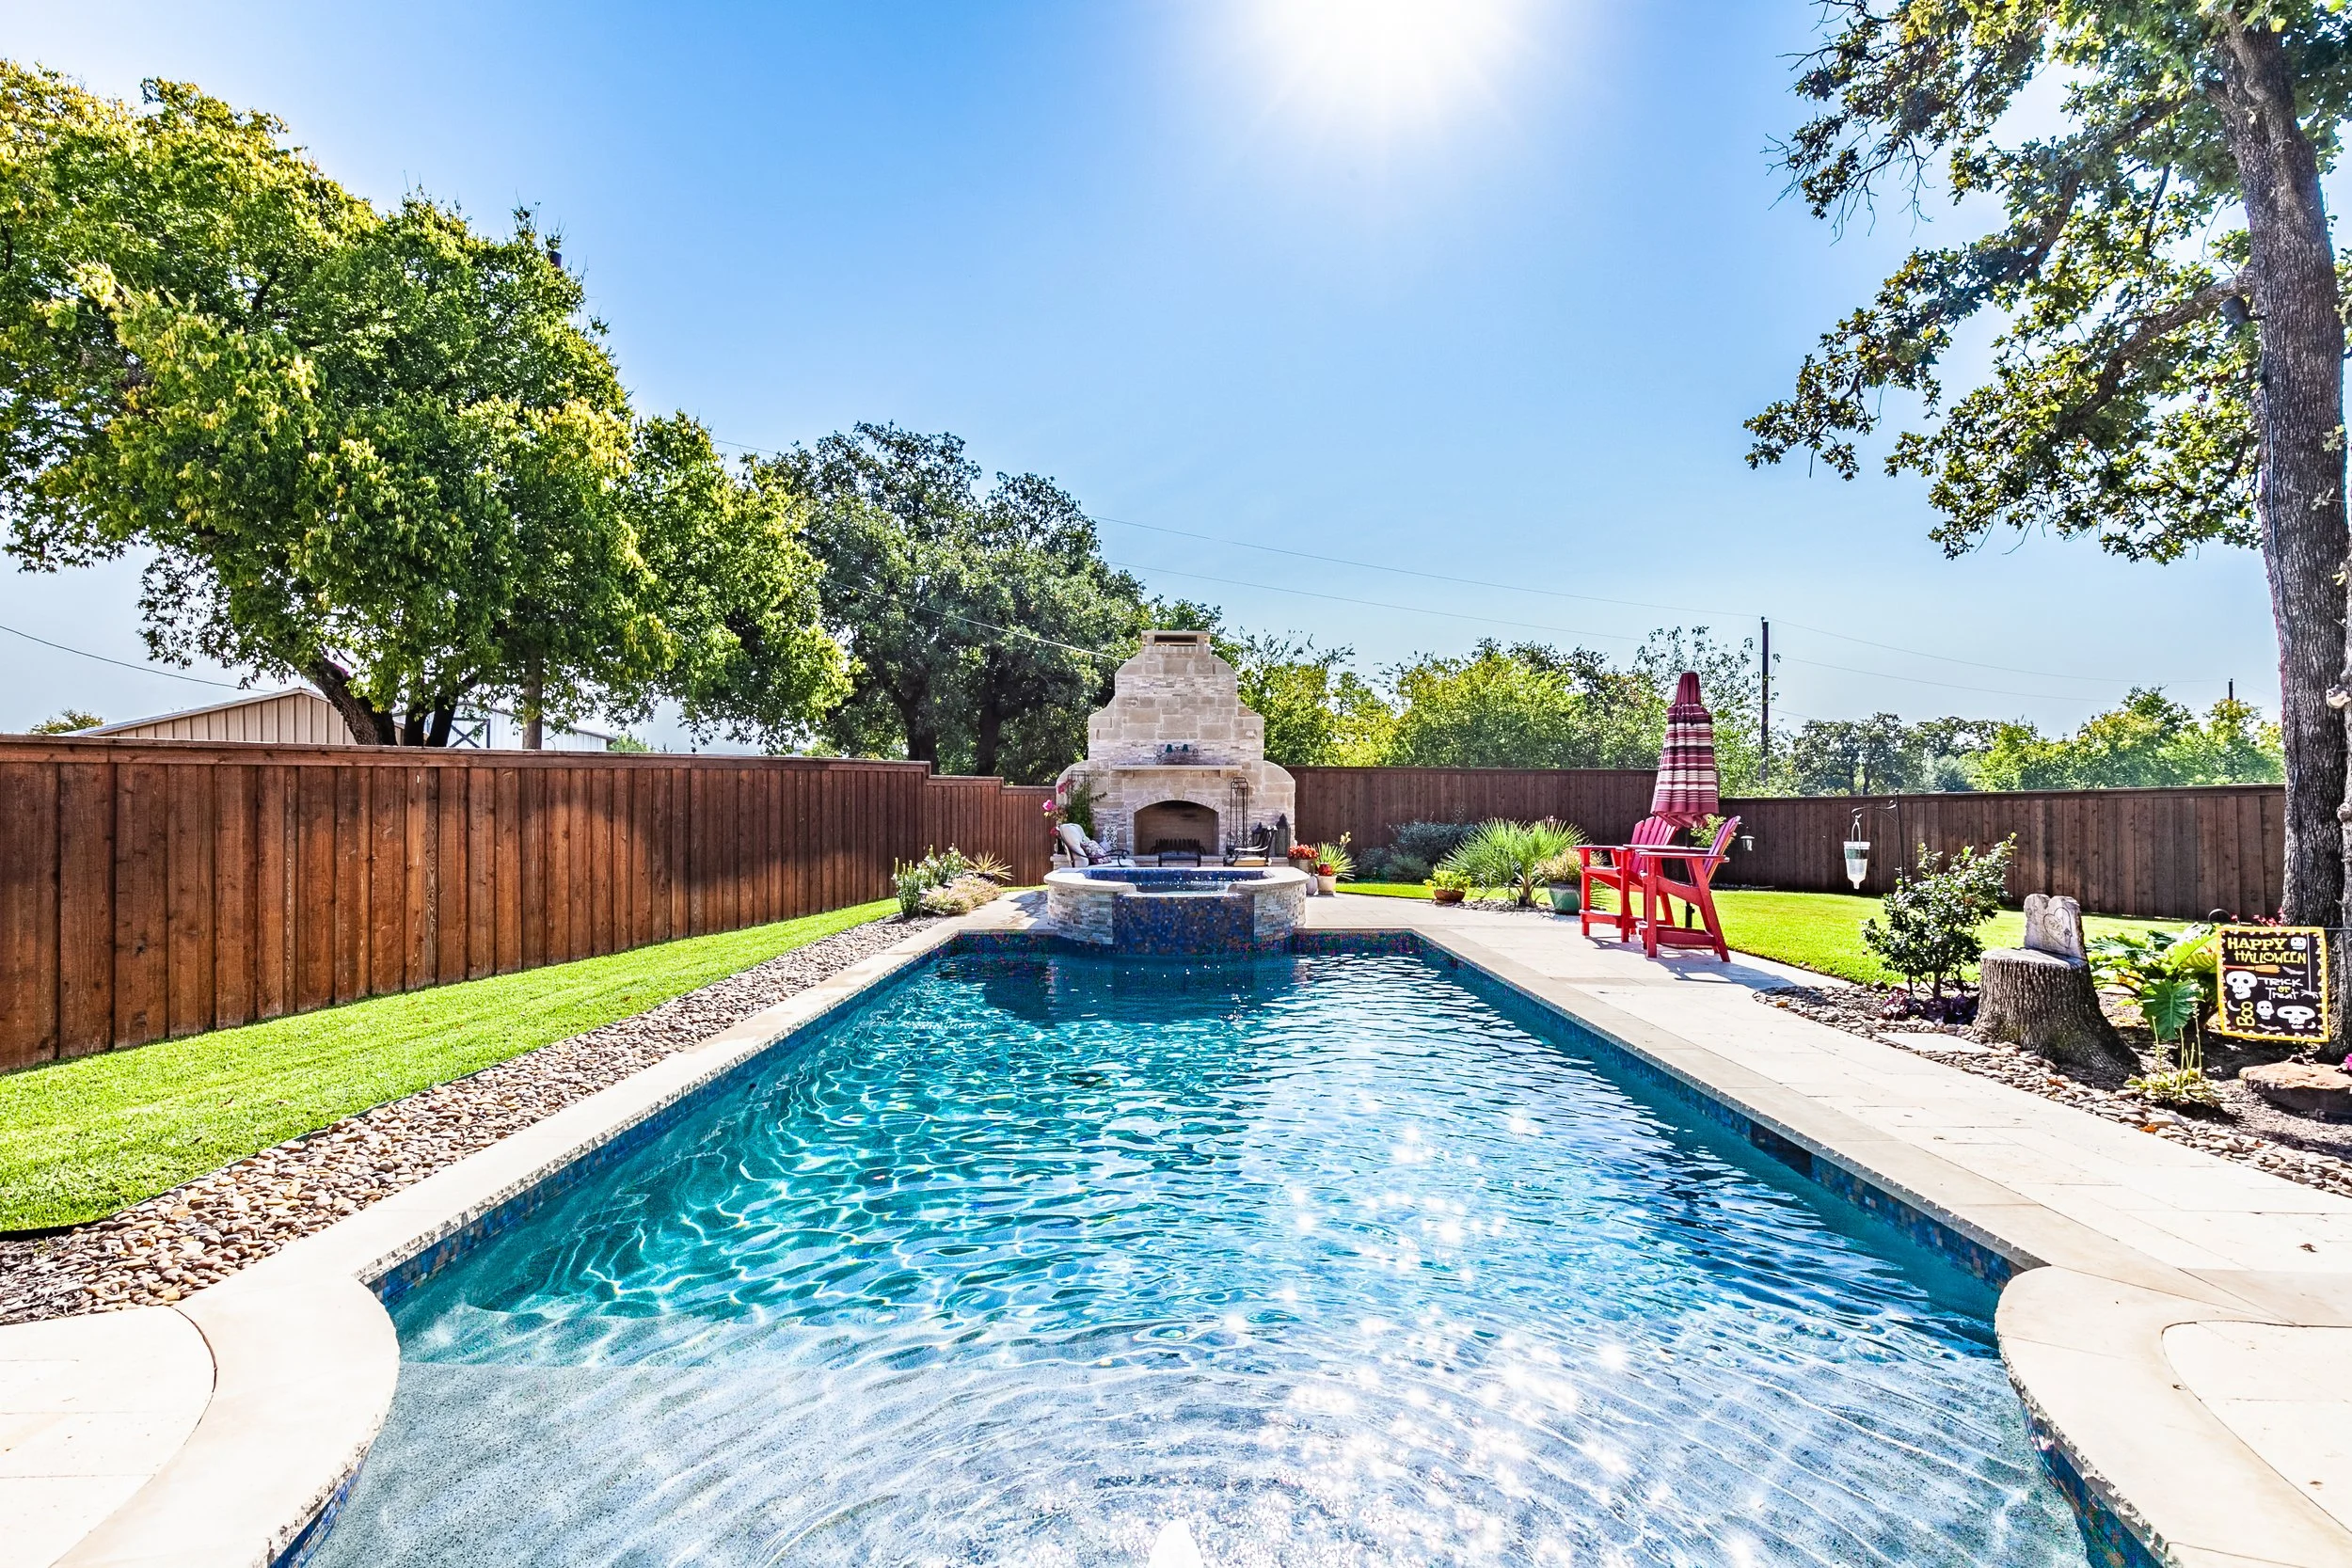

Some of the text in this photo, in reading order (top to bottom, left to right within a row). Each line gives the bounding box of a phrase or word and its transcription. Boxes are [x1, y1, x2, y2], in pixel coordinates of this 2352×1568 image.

[2227, 937, 2288, 950] HAPPY
[2233, 950, 2307, 964] HALLOWEEN
[2258, 977, 2303, 987] TRICK
[2265, 987, 2299, 1000] Treat
